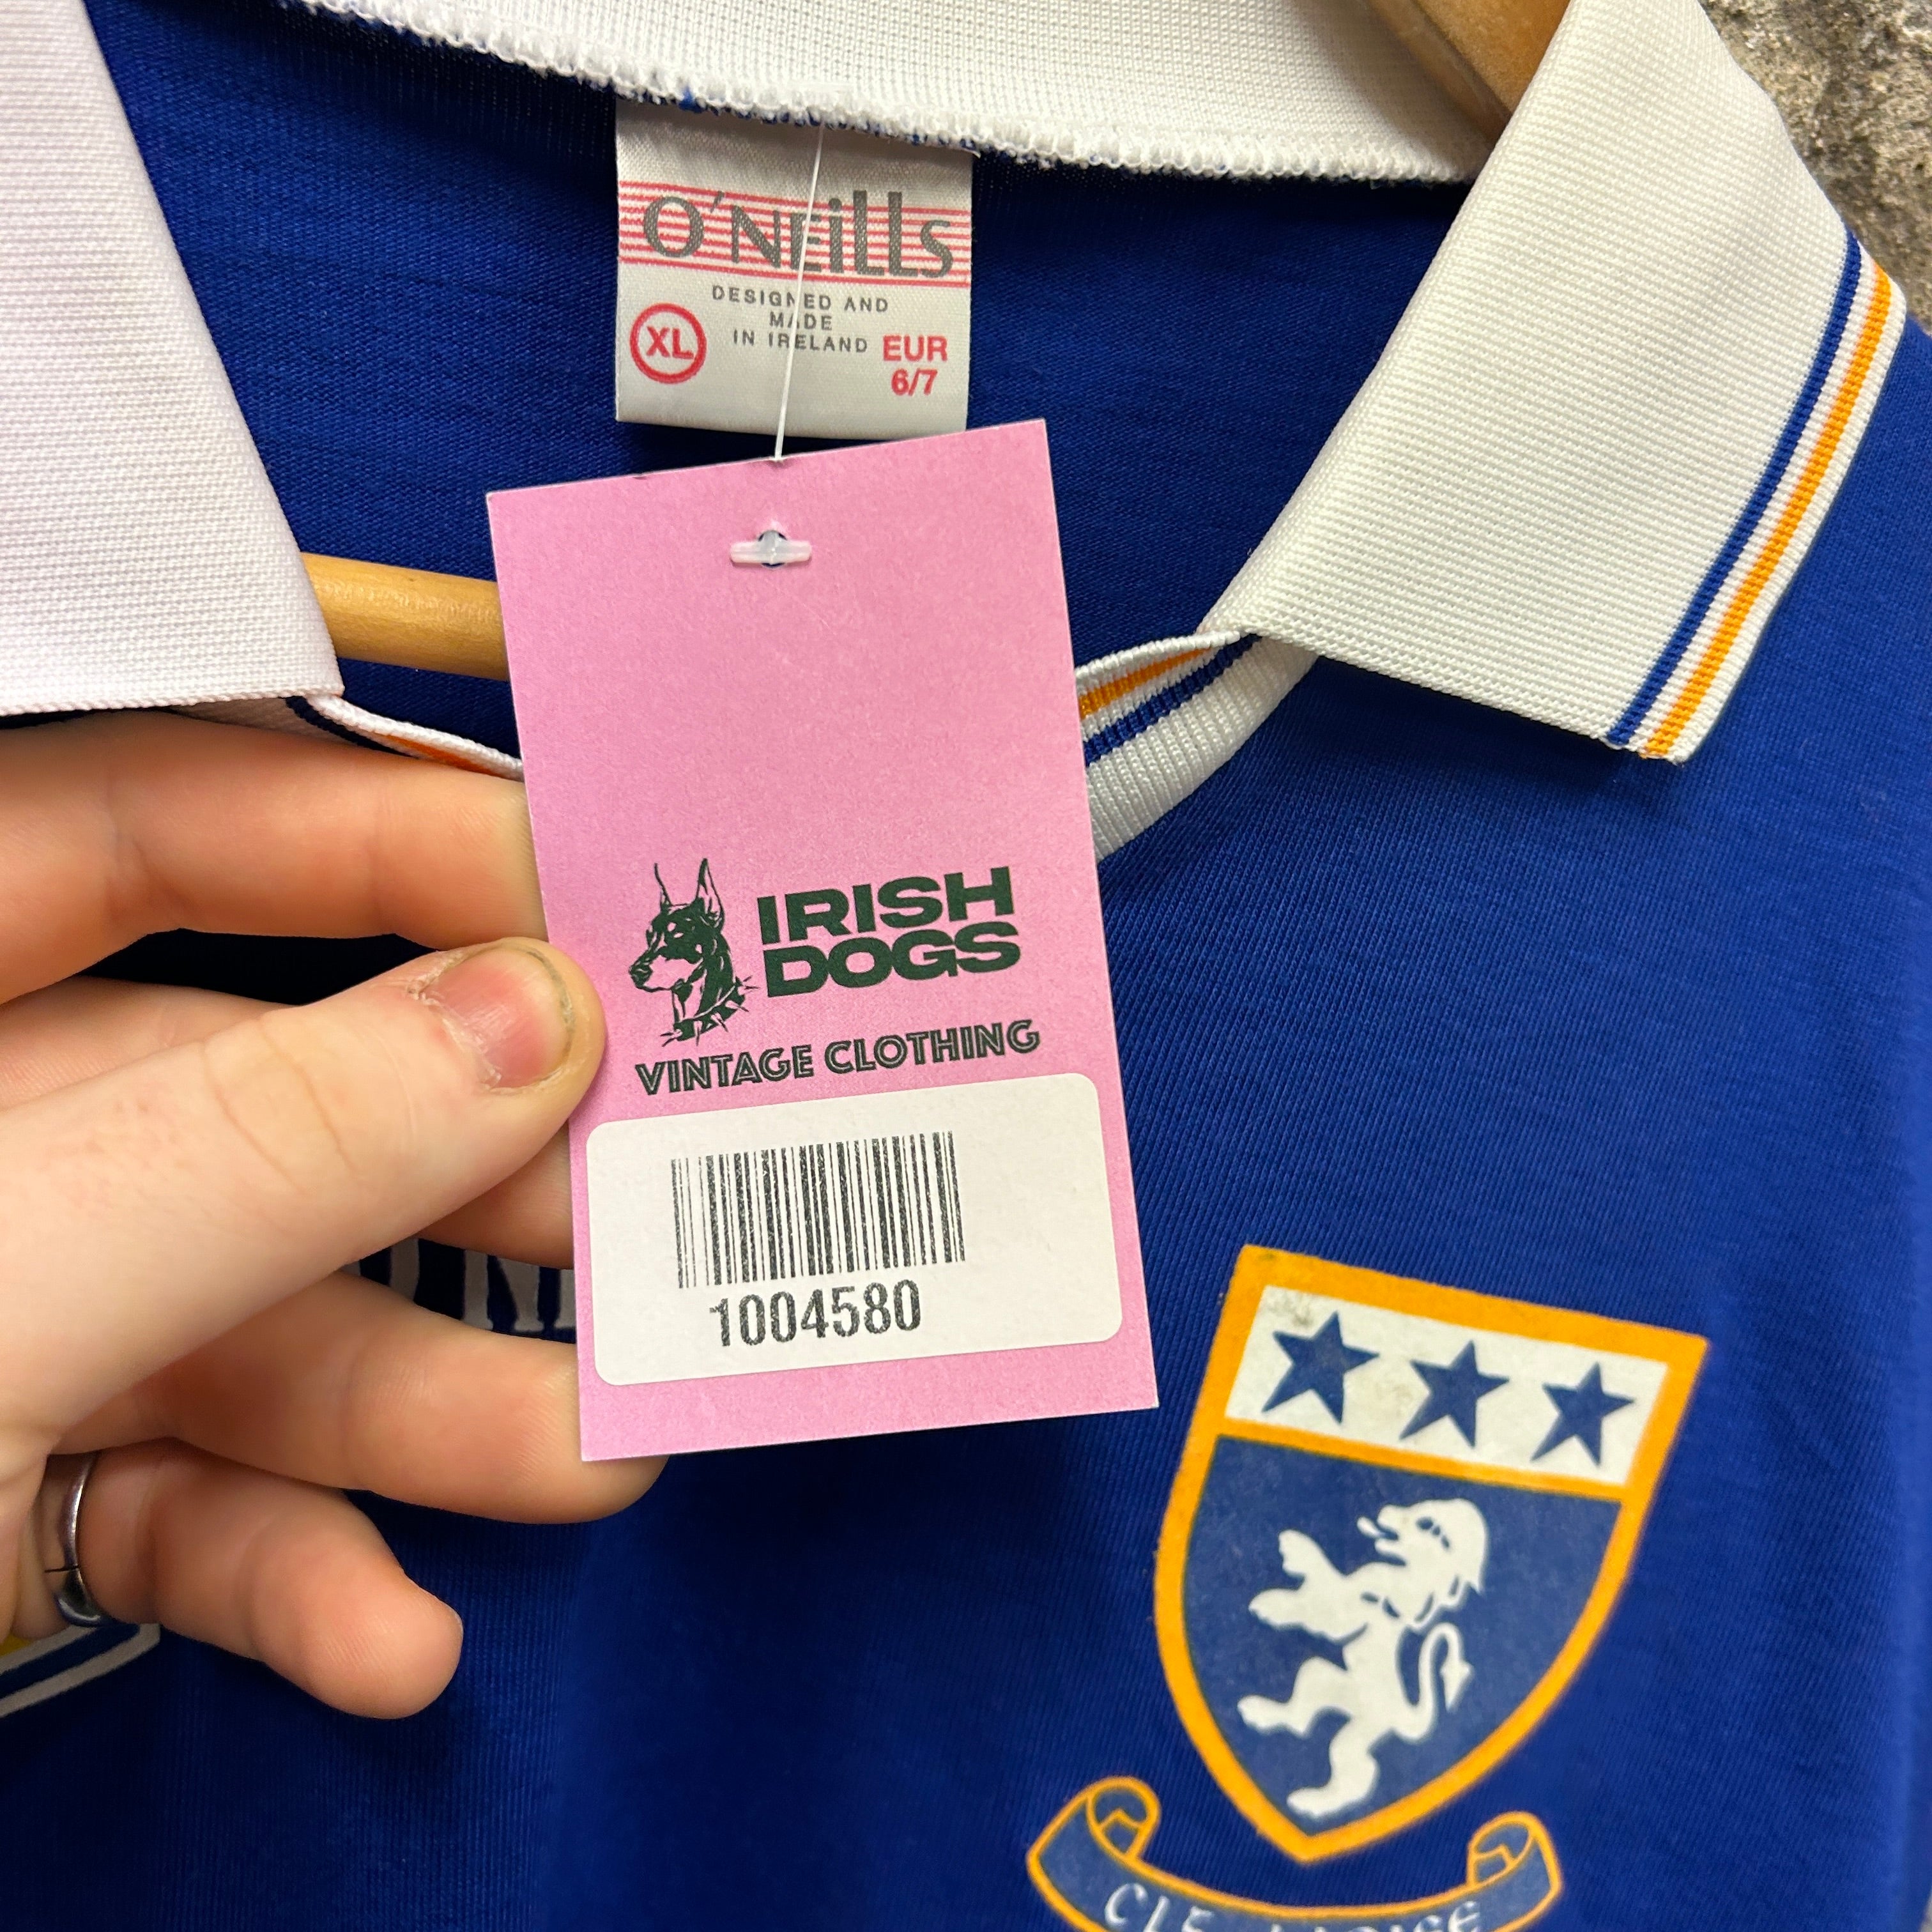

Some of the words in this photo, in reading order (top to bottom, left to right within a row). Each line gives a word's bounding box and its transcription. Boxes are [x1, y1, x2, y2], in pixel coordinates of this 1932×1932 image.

[712, 285, 832, 310] DESIGNED
[844, 296, 889, 313] AND
[645, 326, 695, 360] XL
[733, 329, 756, 346] IN
[769, 333, 868, 353] IRELAND
[882, 335, 948, 362] EUR
[891, 368, 938, 397] 6/7
[756, 866, 1015, 945] IRISH
[763, 921, 1022, 998] DOGS
[634, 1044, 815, 1096] VINTAGE
[824, 1019, 1041, 1074] CLOTHING
[709, 1279, 921, 1347] 1004580
